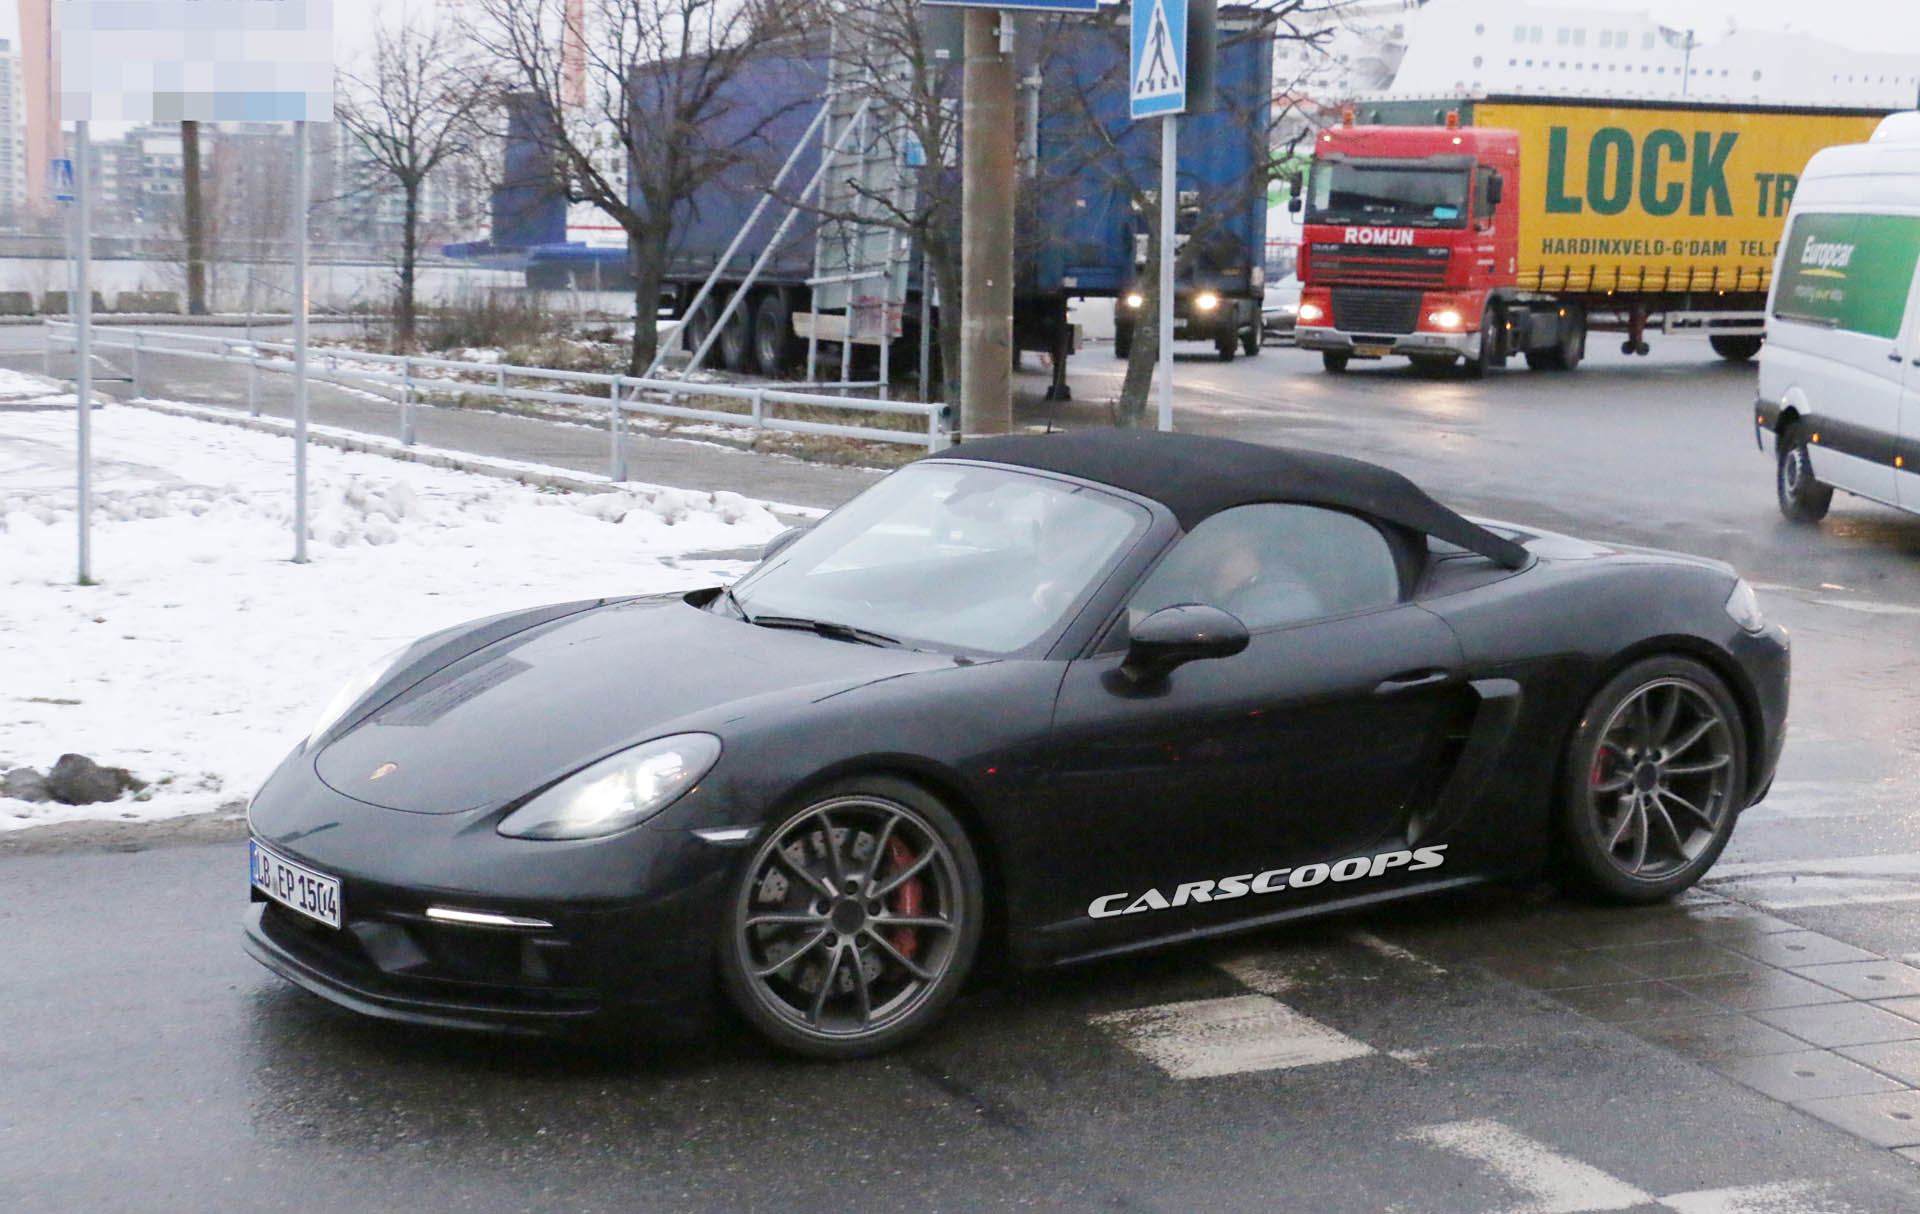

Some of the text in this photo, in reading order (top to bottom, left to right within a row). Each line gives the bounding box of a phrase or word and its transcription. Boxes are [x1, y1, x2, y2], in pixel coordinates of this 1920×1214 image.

[1545, 126, 1740, 216] LOCK
[1542, 238, 1727, 257] HARDINXVELD-G'DAM
[1800, 235, 1855, 271] Europcar
